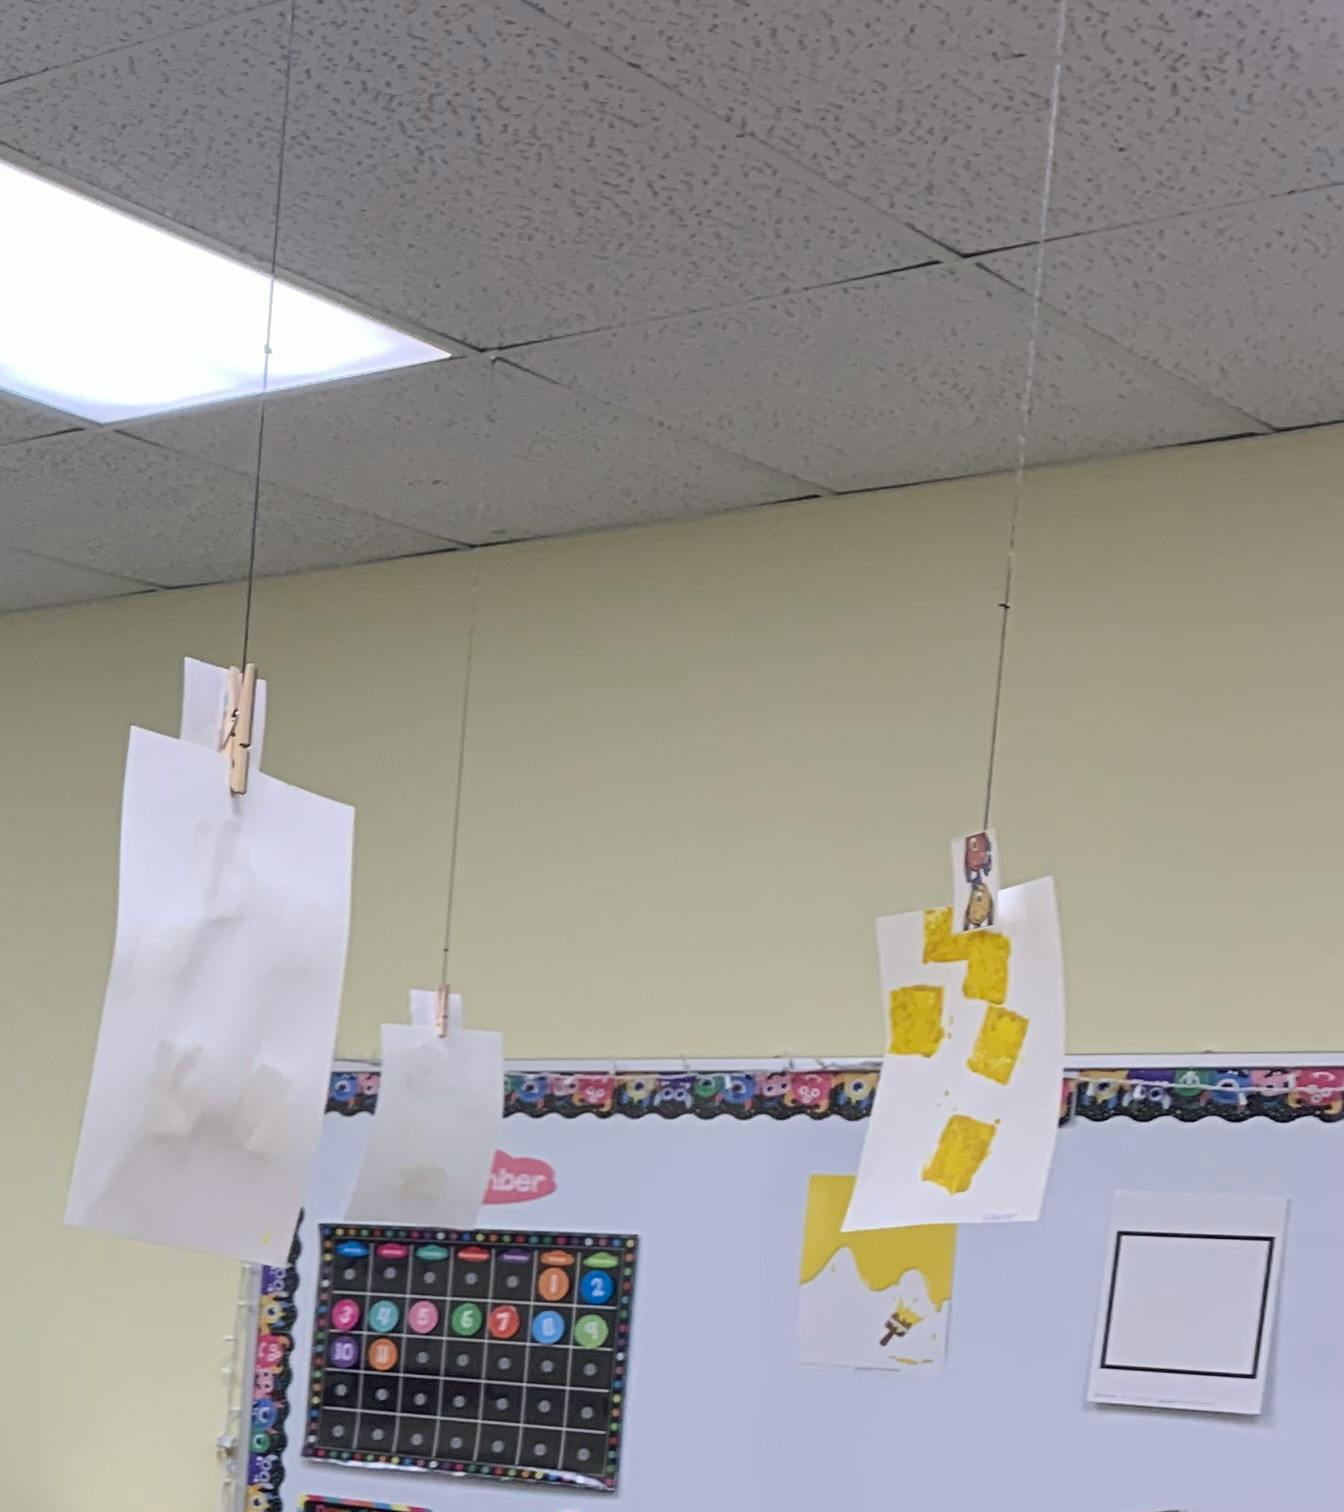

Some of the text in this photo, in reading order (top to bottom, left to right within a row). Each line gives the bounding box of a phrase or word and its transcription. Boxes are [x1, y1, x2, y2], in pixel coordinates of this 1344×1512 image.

[550, 1274, 605, 1297] 1 2
[340, 1307, 600, 1341] 3 4 5 6 7 8 9
[334, 1342, 354, 1361] 10
